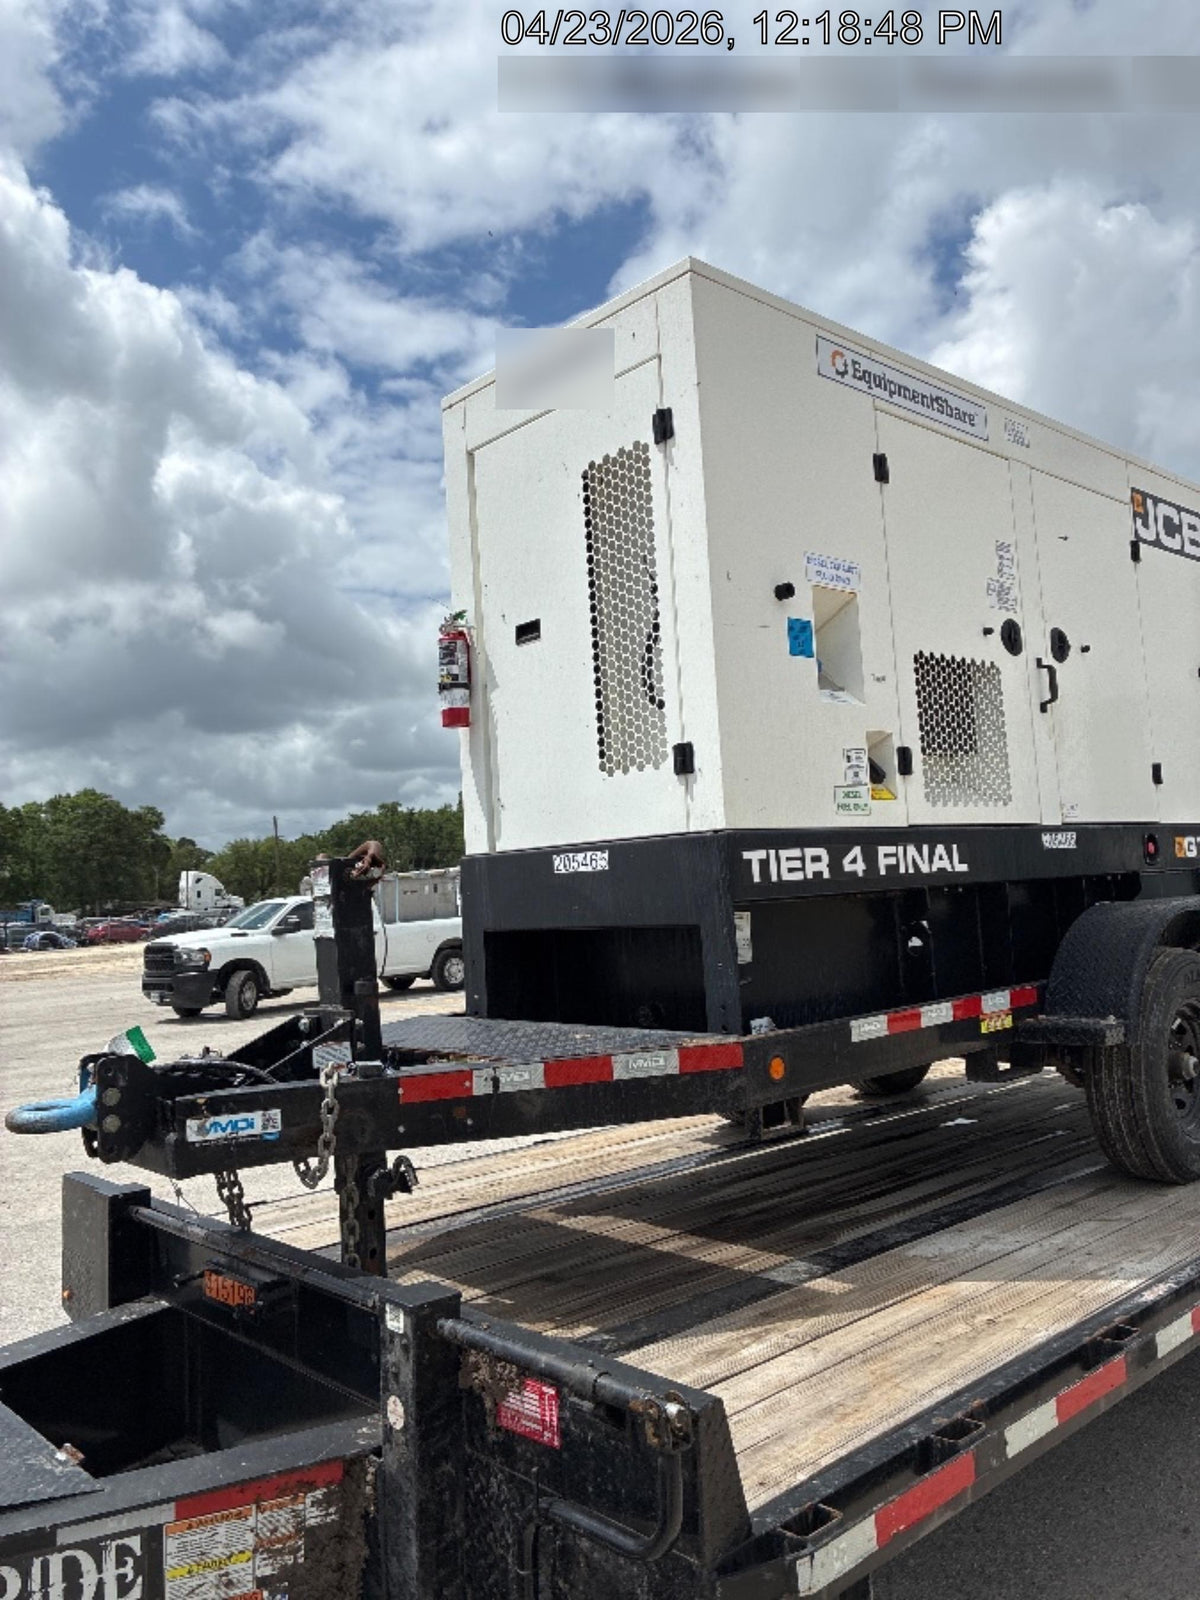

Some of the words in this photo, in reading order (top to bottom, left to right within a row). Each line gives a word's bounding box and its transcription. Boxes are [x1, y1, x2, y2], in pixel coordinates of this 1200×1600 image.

[851, 359, 976, 427] EquipmentShare
[1136, 497, 1200, 556] JCB
[742, 848, 831, 883] TIER
[842, 848, 867, 877] 4
[878, 844, 969, 875] FINAL
[1184, 836, 1200, 858] G
